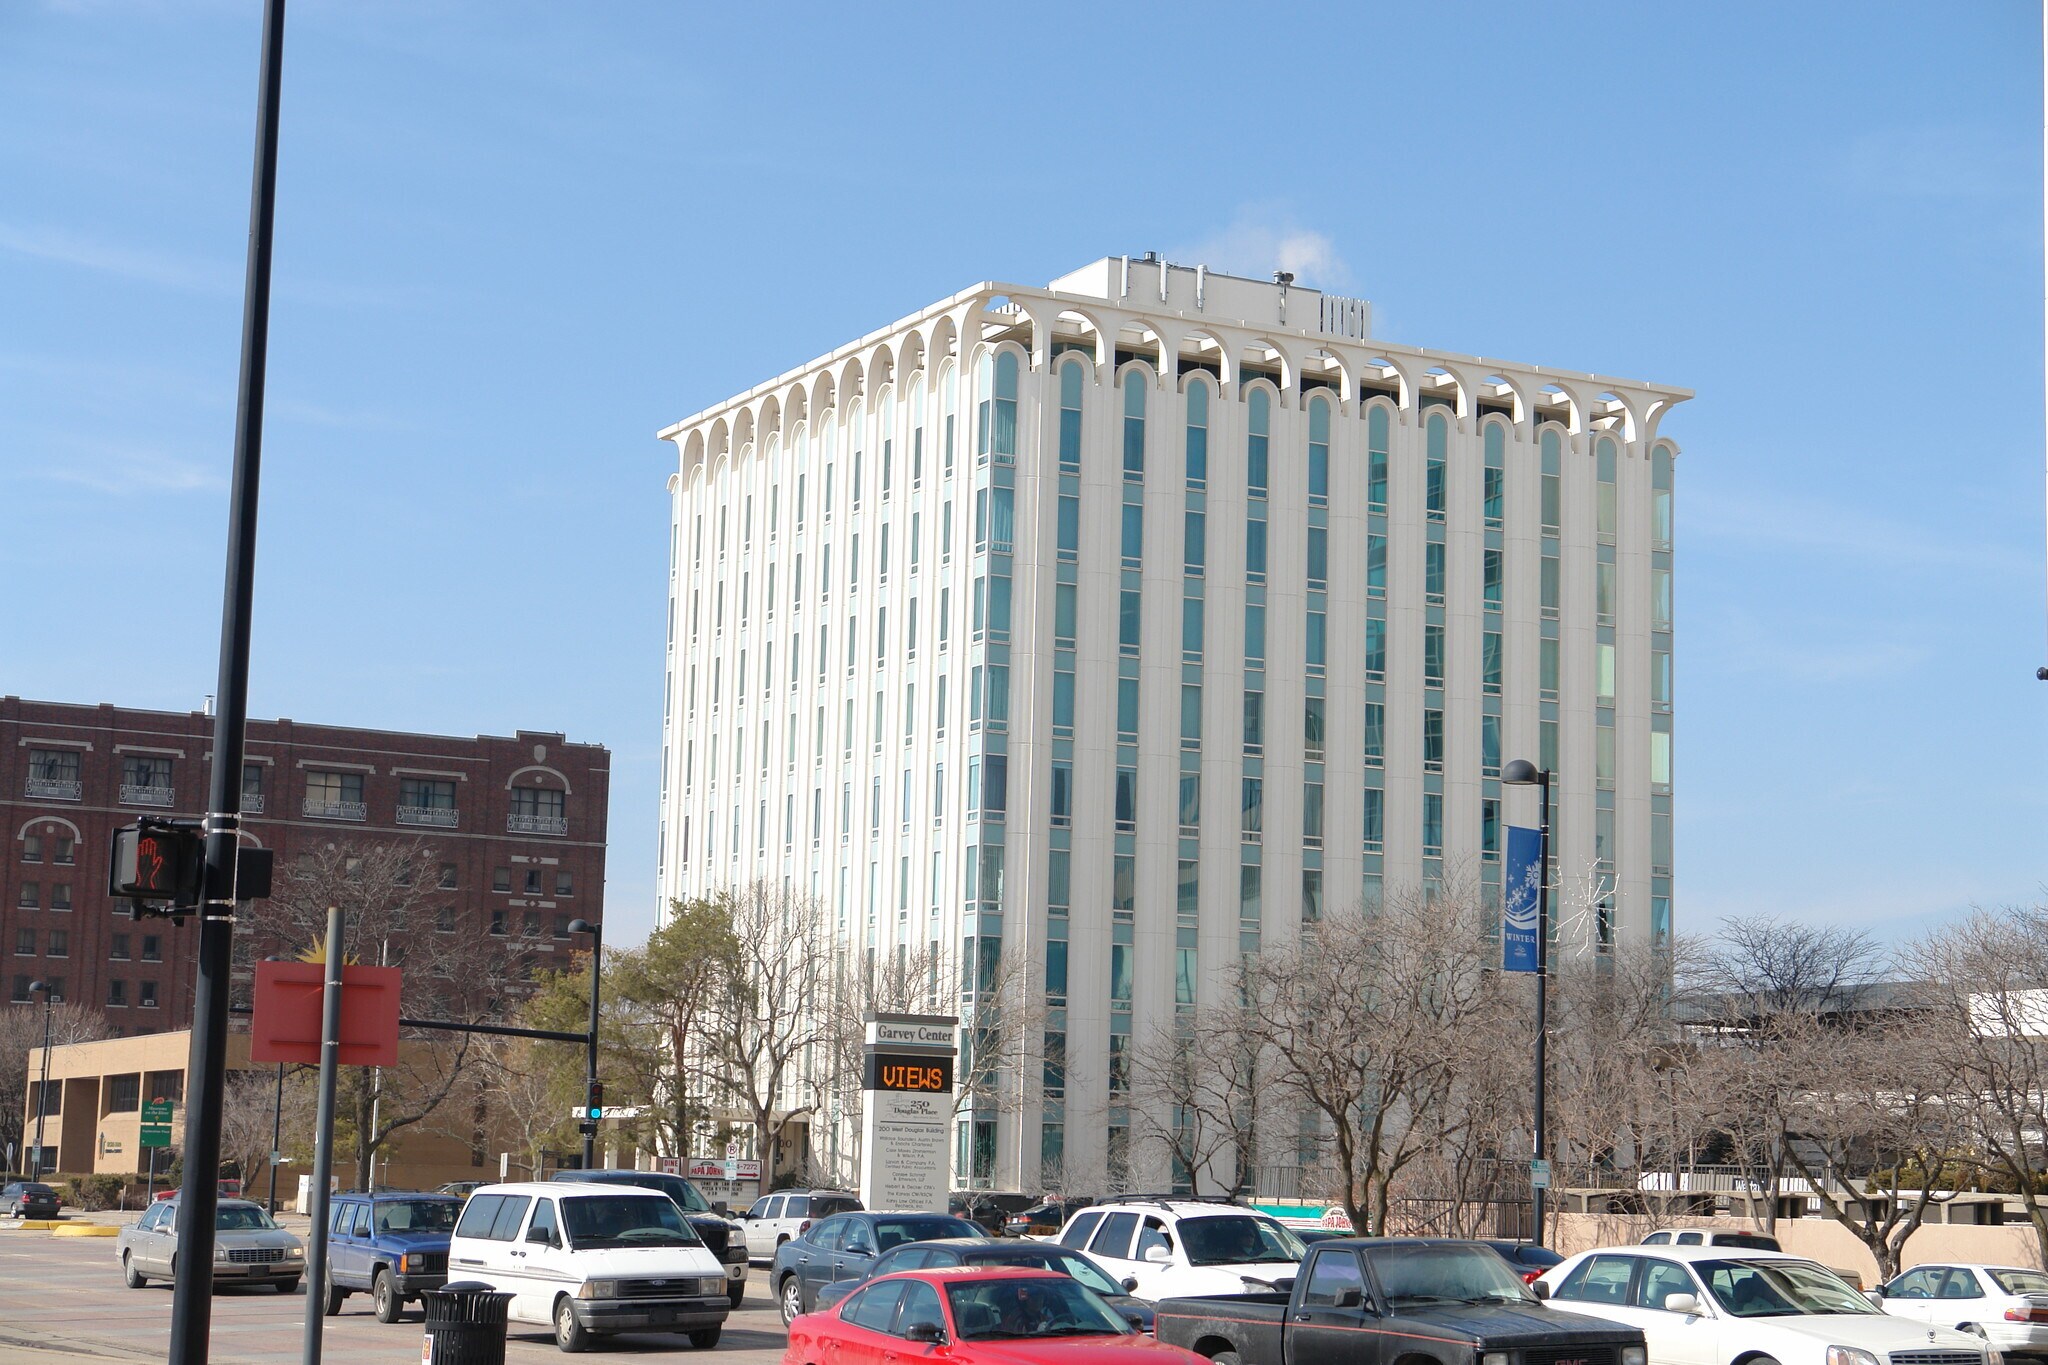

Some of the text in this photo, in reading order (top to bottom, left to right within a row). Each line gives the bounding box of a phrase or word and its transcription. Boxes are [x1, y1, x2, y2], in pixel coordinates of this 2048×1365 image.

[1506, 932, 1535, 943] WINTER
[878, 1025, 953, 1043] Garvey Center
[883, 1066, 943, 1089] VIEWS
[910, 1100, 930, 1109] 250
[893, 1107, 919, 1116] Douglas
[926, 1127, 944, 1135] Building
[664, 1159, 678, 1167] DINE
[690, 1165, 704, 1175] PAPA
[1735, 1180, 1760, 1191] Wetar
